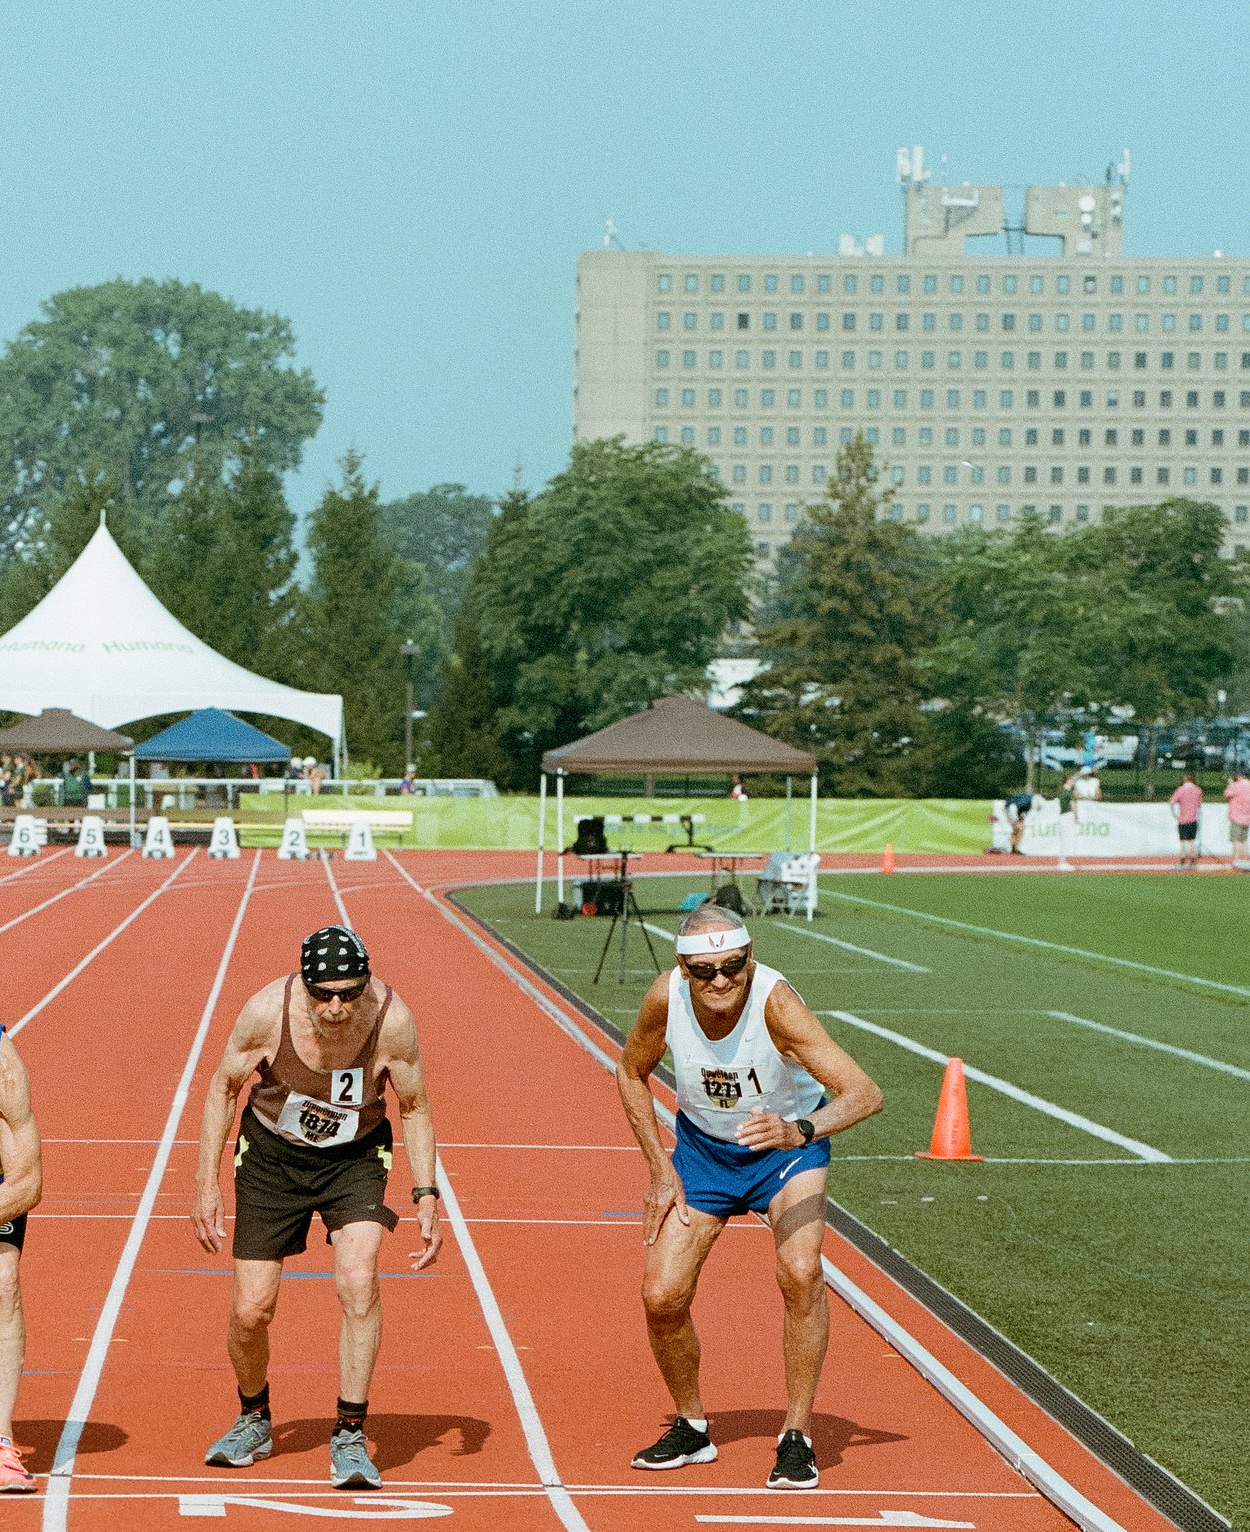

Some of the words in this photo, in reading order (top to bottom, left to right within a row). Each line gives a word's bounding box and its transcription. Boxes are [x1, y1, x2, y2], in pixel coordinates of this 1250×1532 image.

[20, 828, 30, 842] 6
[86, 829, 97, 844] 5
[153, 830, 164, 844] 4
[219, 830, 230, 845] 3
[290, 831, 300, 846] 2
[358, 832, 366, 847] 1
[339, 1073, 353, 1101] 2
[747, 1067, 763, 1095] 1
[702, 1080, 743, 1098] 1271
[298, 1110, 341, 1138] 1874
[178, 1496, 454, 1518] 2
